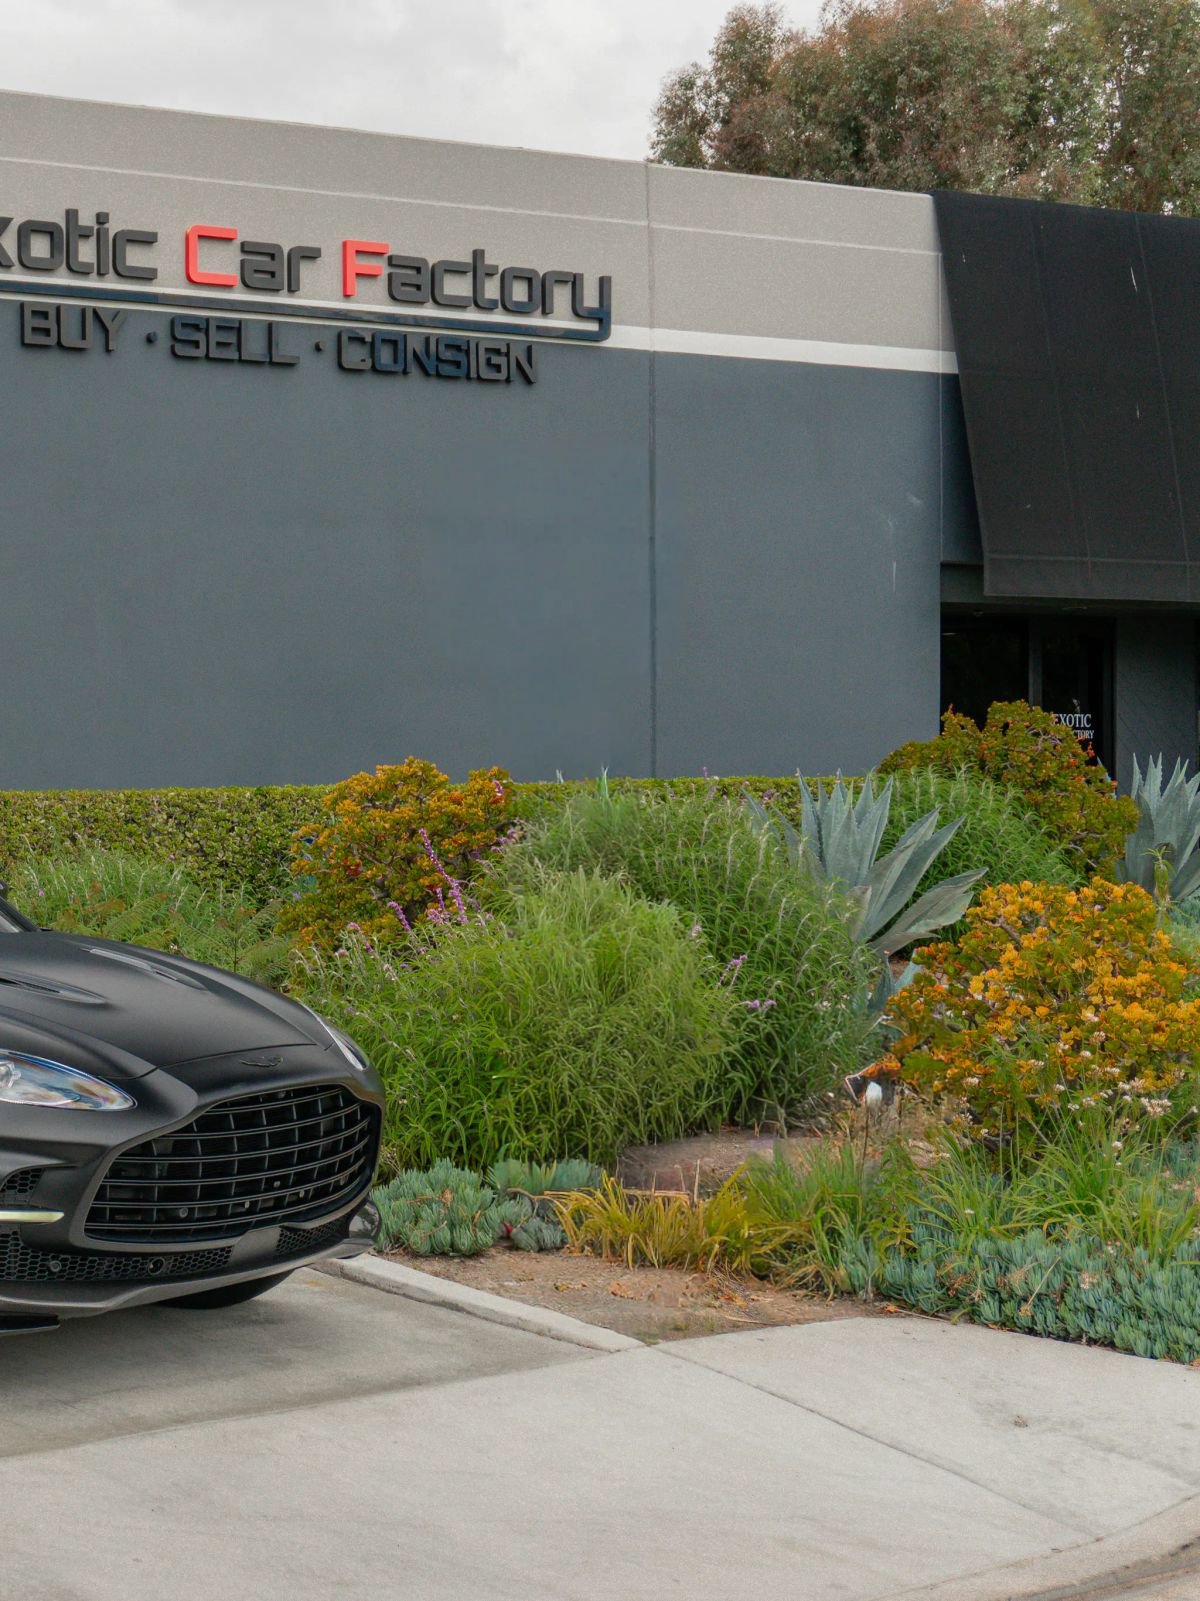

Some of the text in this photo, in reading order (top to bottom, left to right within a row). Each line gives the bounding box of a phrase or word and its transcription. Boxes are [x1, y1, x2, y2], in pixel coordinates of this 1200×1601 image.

[185, 224, 321, 292] Car
[342, 240, 612, 341] Factory
[21, 301, 538, 384] BUY SELL CONSIGN
[1052, 713, 1092, 727] EXOTIC
